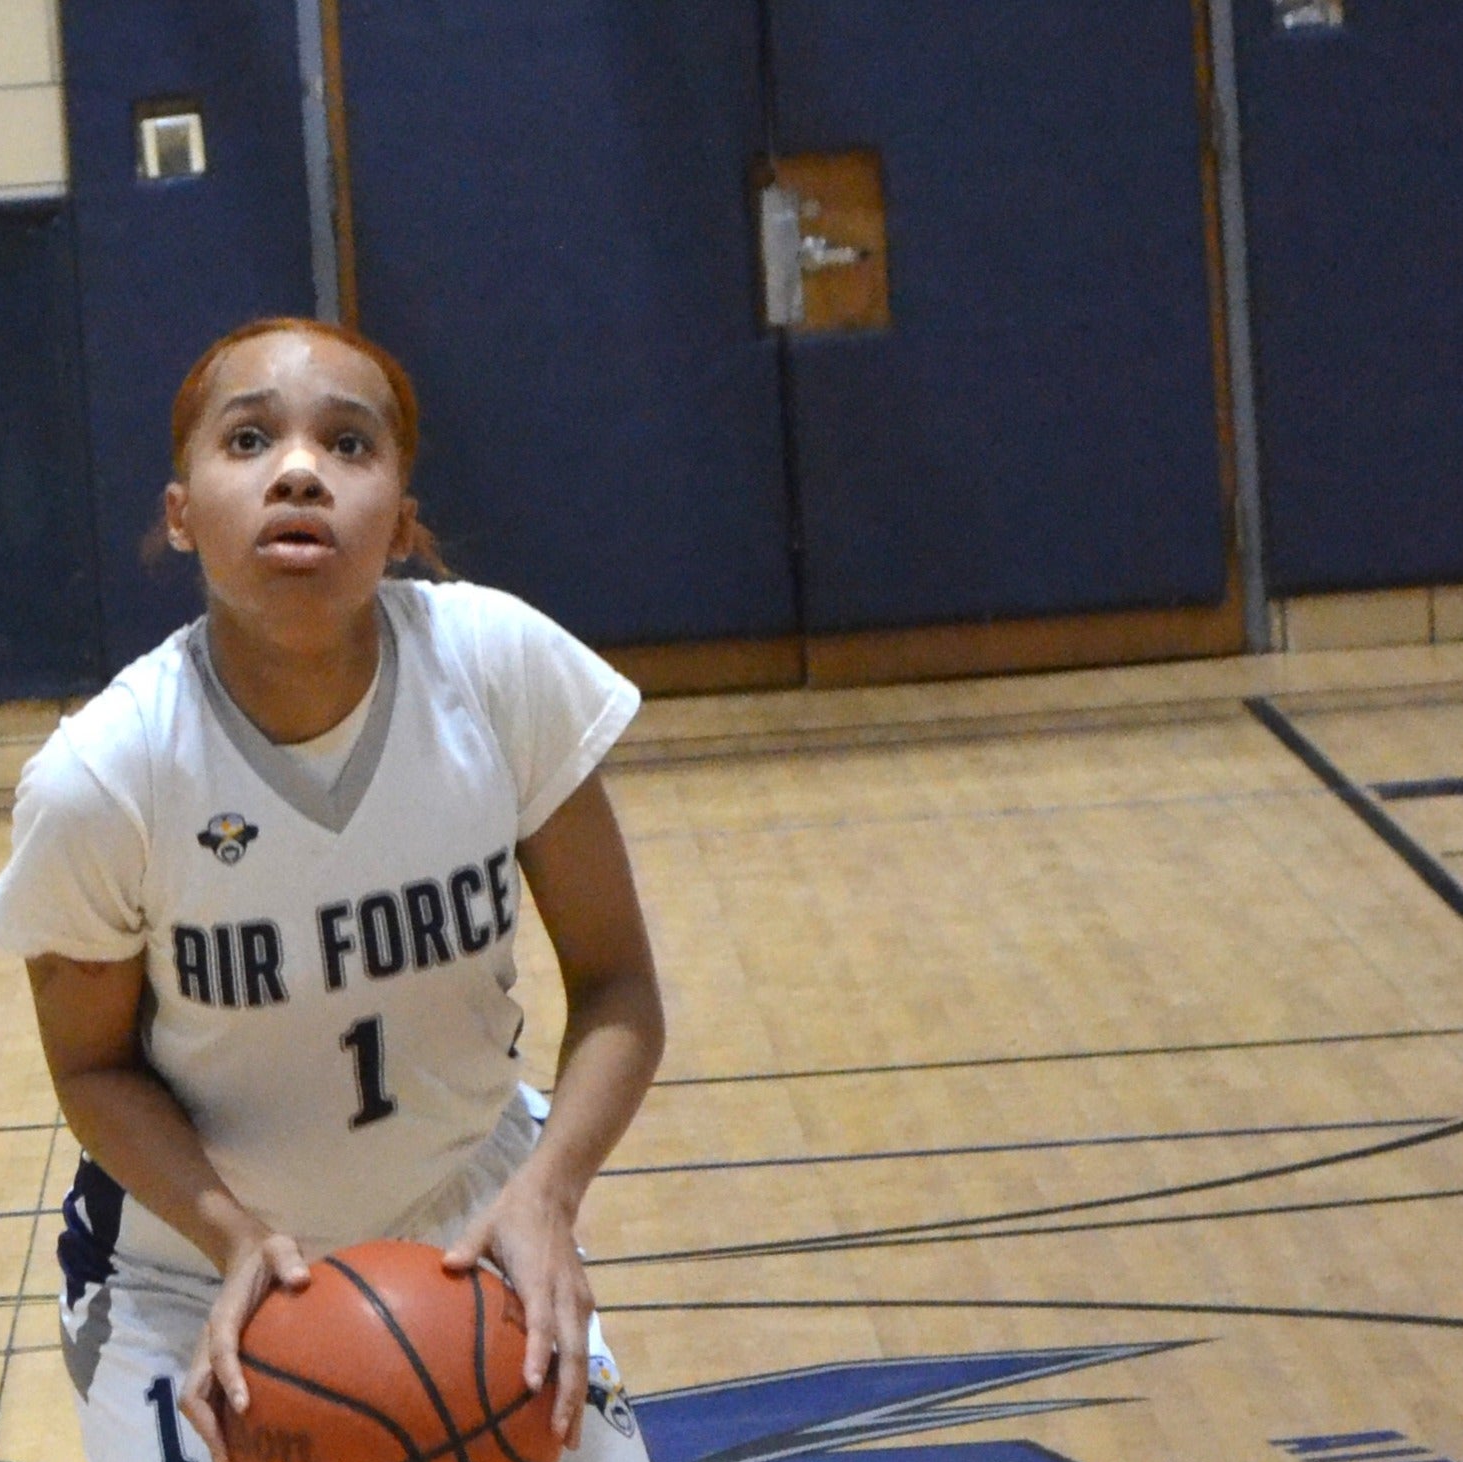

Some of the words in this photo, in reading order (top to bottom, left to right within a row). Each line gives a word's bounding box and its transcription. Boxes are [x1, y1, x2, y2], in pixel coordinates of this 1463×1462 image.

[171, 916, 290, 1009] AIR
[316, 846, 514, 993] FORCE
[340, 1013, 398, 1131] 1
